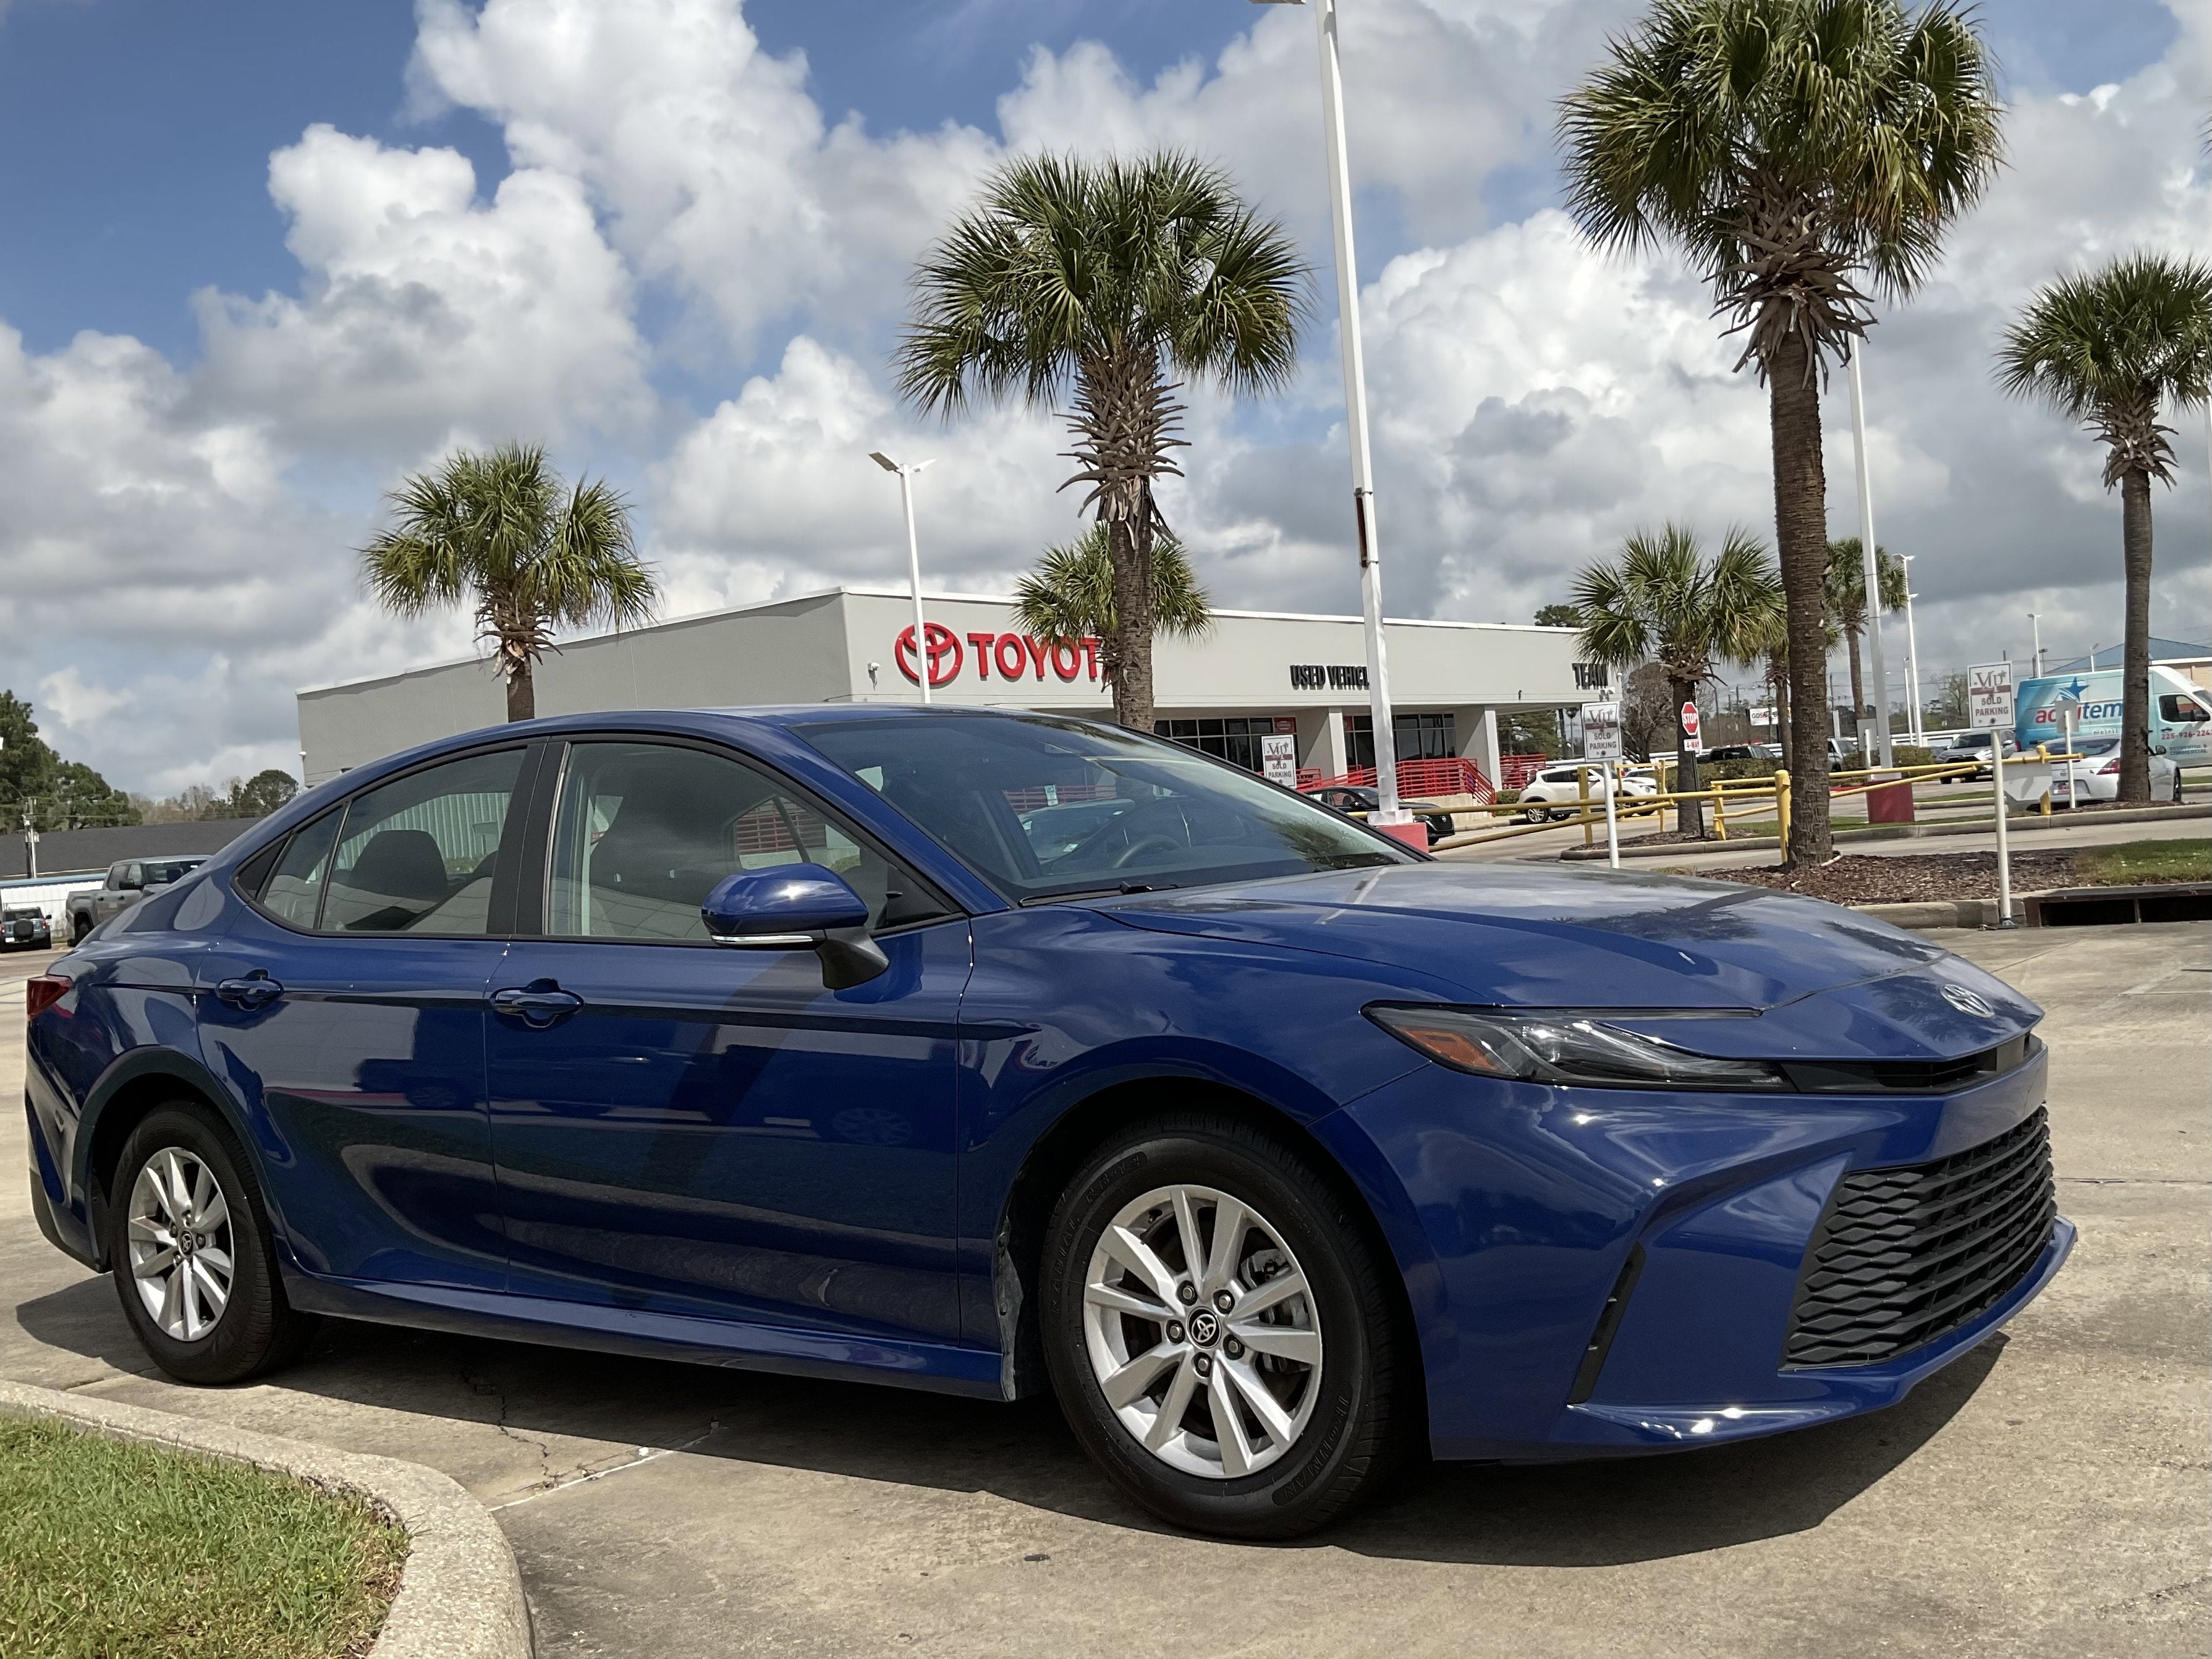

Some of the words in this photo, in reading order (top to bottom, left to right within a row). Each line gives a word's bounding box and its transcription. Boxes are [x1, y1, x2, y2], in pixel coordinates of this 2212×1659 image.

[967, 633, 1111, 679] TOYOT
[1290, 664, 1326, 686] USED
[1326, 665, 1370, 686] VEHICL
[1572, 663, 1608, 686] TEAM
[1981, 697, 2001, 705] SOLD
[1975, 706, 2009, 716] PARKING
[2035, 702, 2123, 724] actem
[1684, 713, 1697, 724] STOP
[2161, 729, 2212, 740] 225-926-224
[1590, 742, 1616, 750] PARKING
